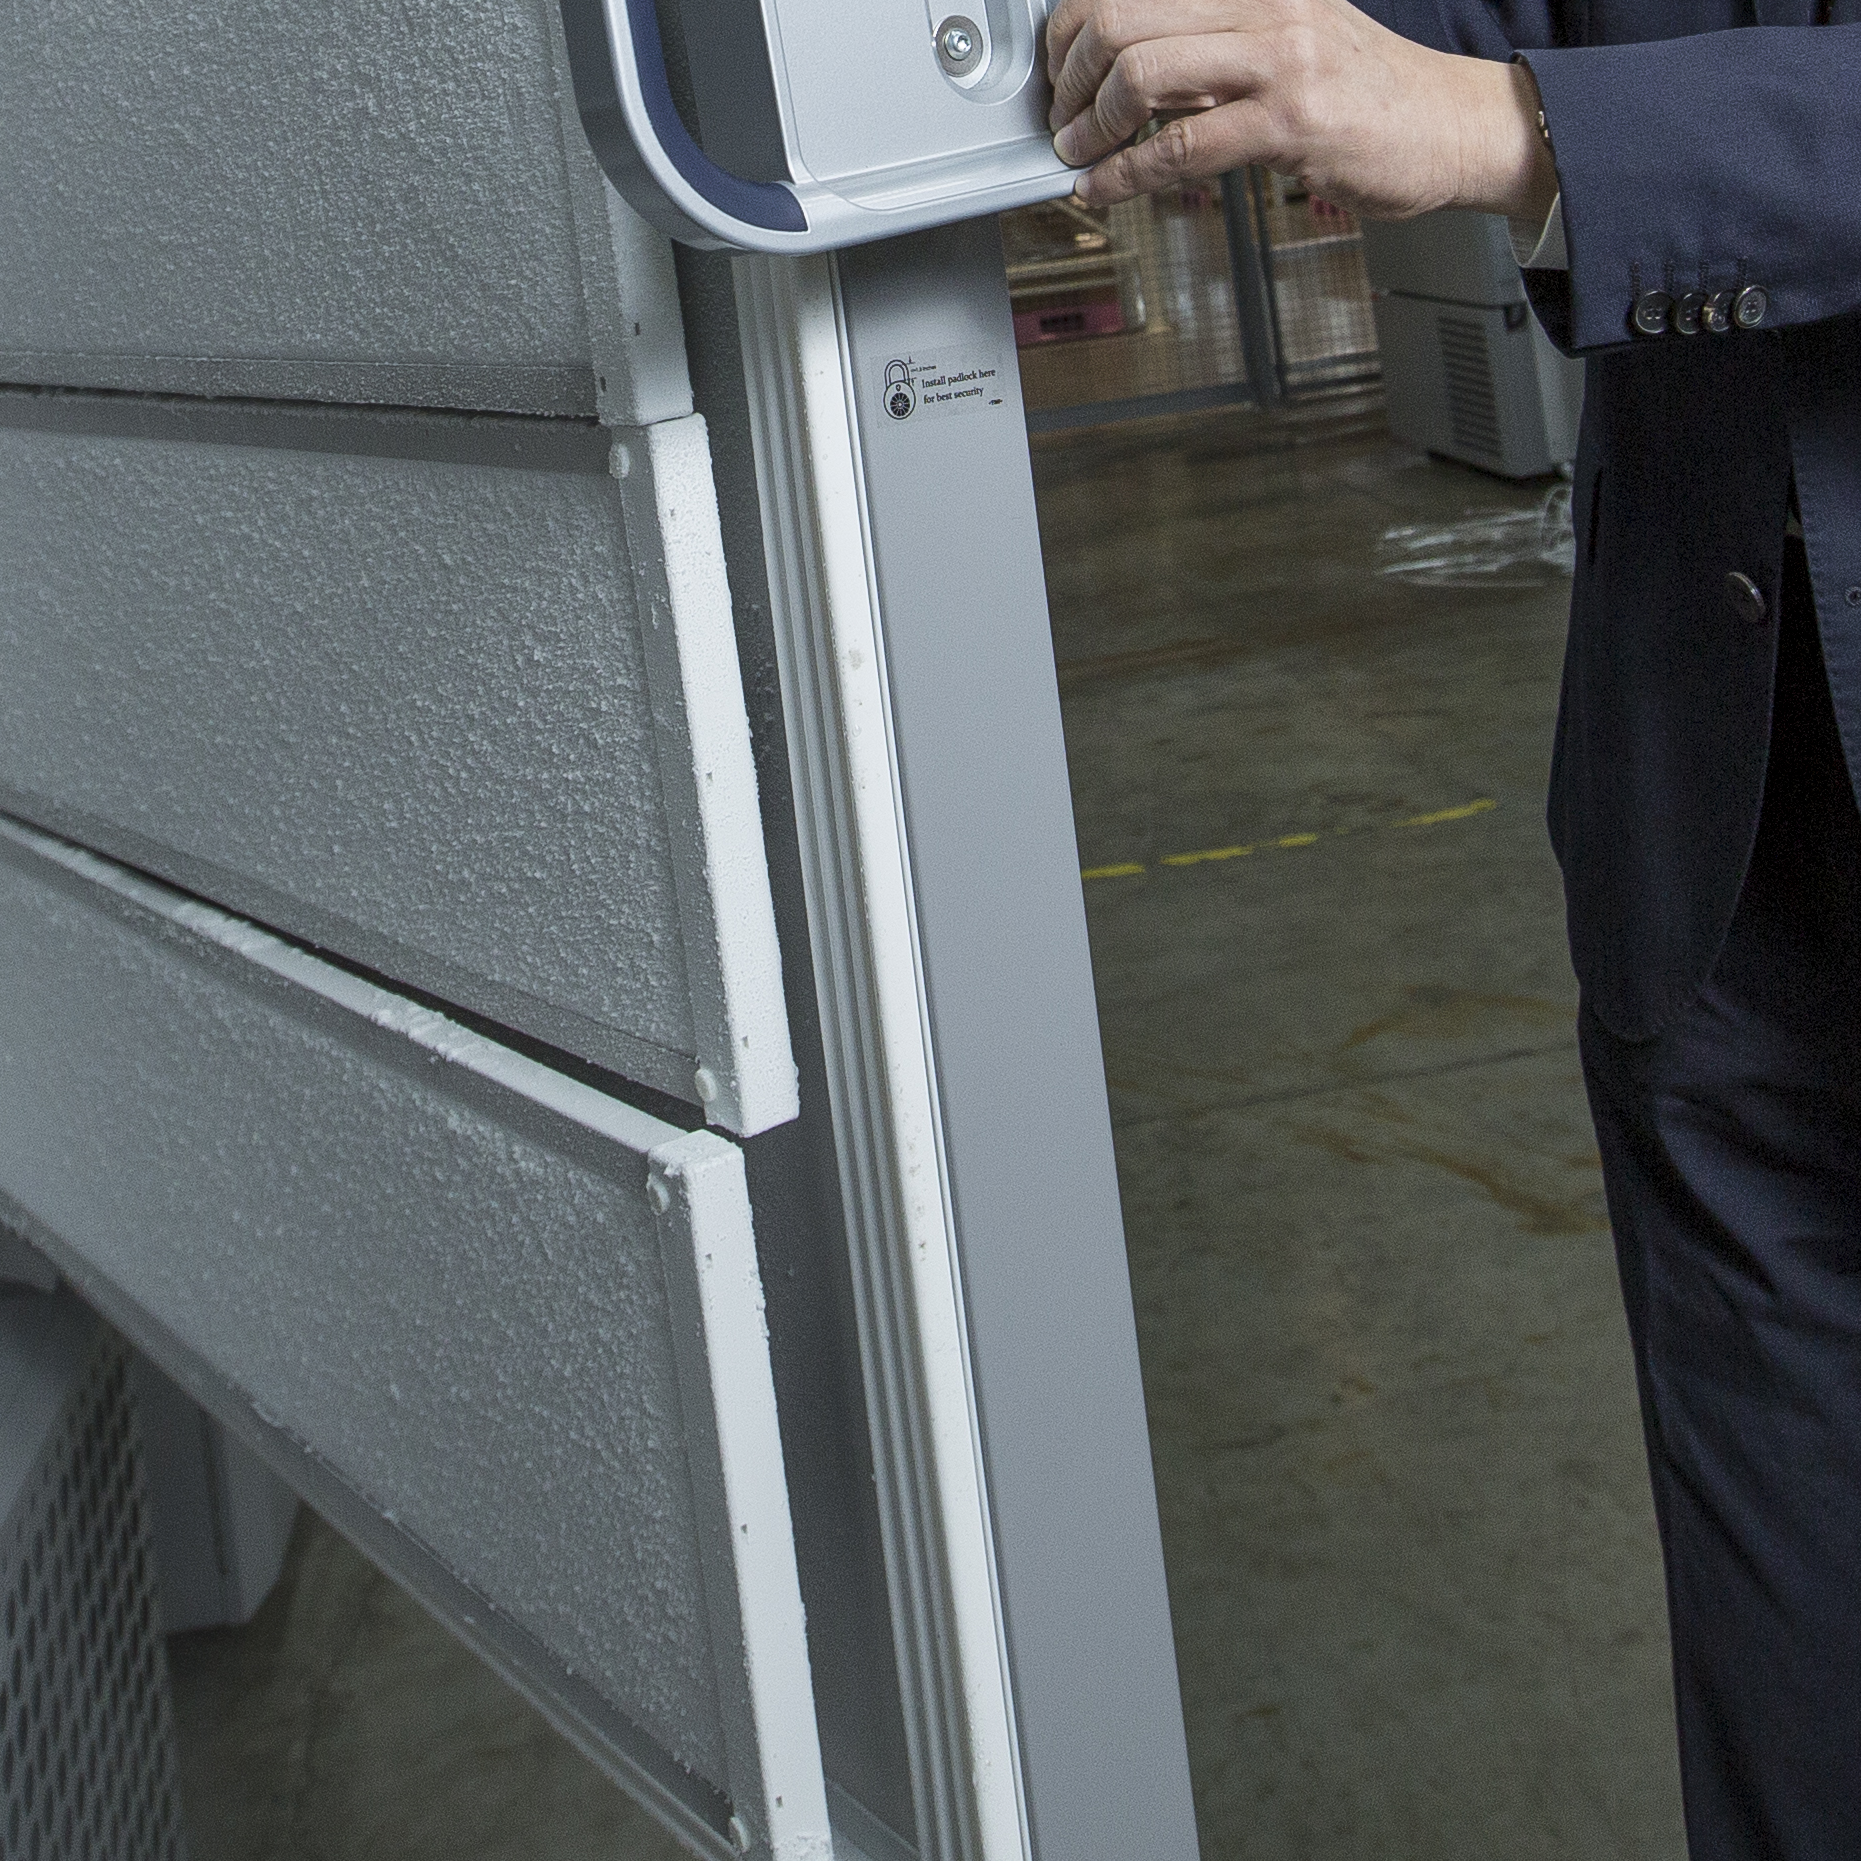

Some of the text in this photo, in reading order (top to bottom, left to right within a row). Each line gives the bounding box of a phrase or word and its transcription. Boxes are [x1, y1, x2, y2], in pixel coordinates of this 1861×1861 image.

[922, 369, 996, 388] Install padlock here
[924, 387, 984, 404] for best security
